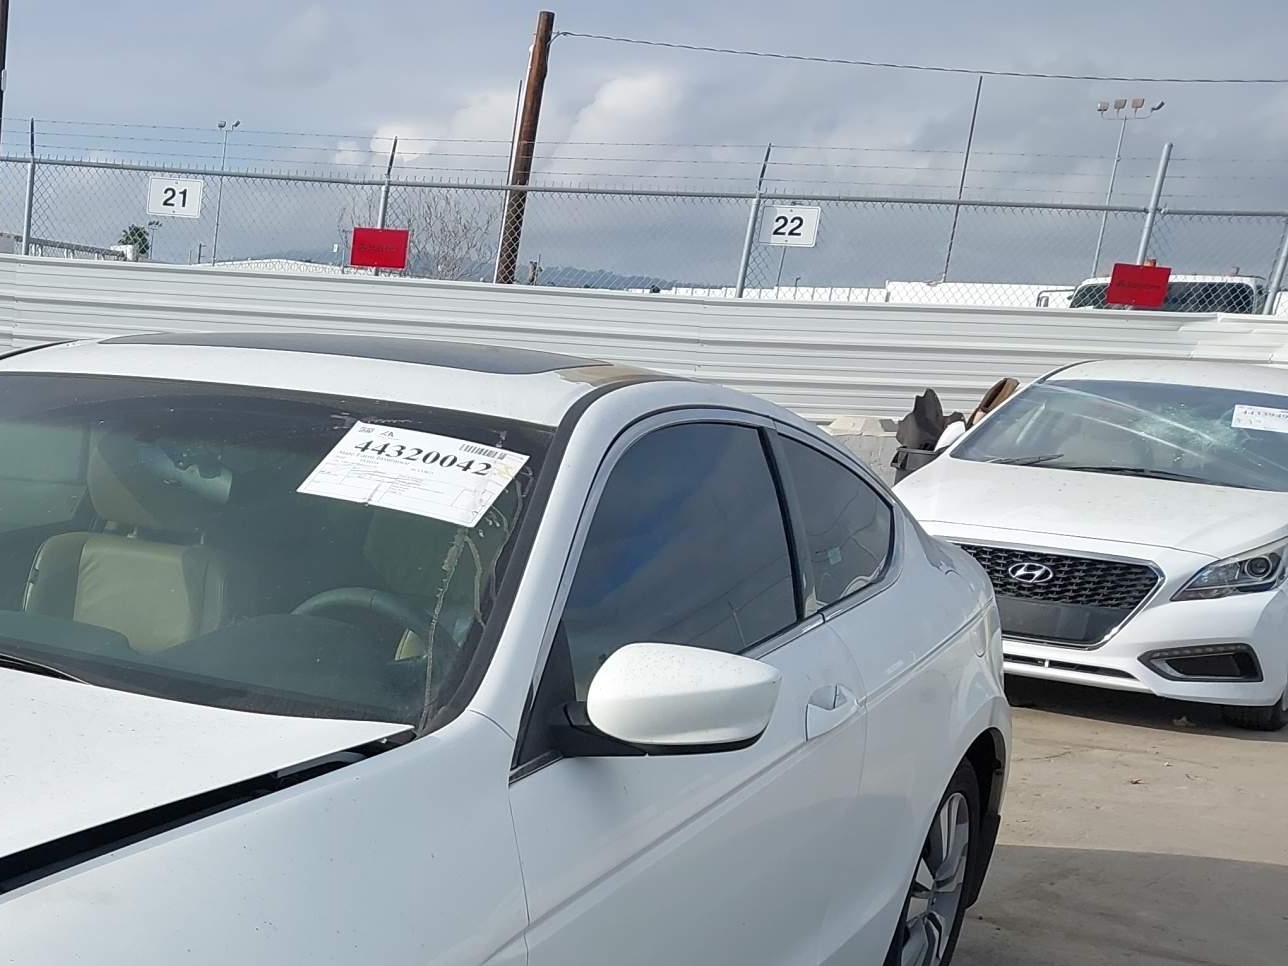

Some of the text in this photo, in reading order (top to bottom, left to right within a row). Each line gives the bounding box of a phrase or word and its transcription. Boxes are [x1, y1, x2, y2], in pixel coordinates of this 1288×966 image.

[162, 187, 188, 208] 21
[772, 215, 804, 237] 22
[355, 440, 491, 476] 44320042
